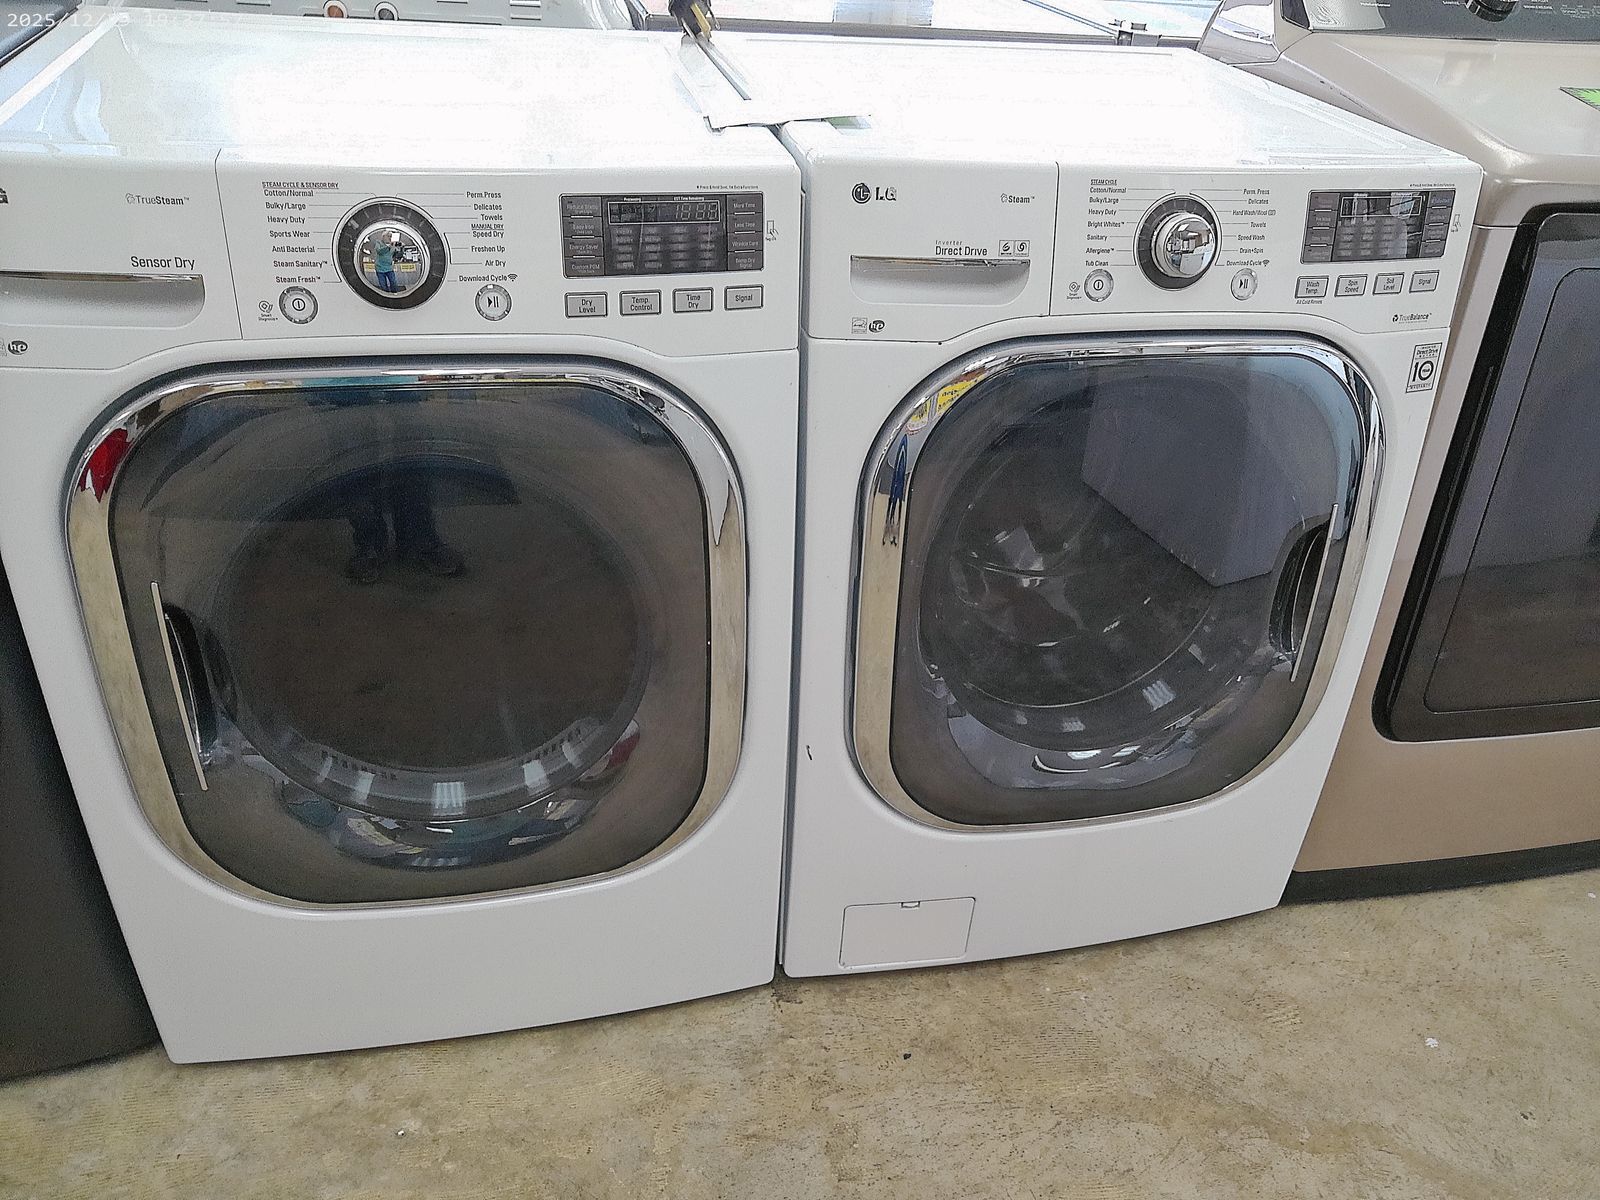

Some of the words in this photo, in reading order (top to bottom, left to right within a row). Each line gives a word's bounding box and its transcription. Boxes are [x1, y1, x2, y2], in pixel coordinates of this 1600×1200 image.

[1089, 196, 1119, 204] Bulky/Large
[266, 202, 306, 210] Bulky/Large
[267, 216, 288, 224] Heavy
[290, 216, 305, 224] Duty
[472, 231, 492, 239] Speed
[935, 246, 962, 256] Direct
[964, 246, 988, 256] Drive
[130, 256, 172, 268] Sensor
[174, 256, 195, 270] Dry
[495, 260, 506, 268] Dry
[490, 274, 508, 282] Cycle
[735, 294, 753, 302] Signal
[581, 298, 592, 307] Dry
[688, 301, 700, 310] Dry
